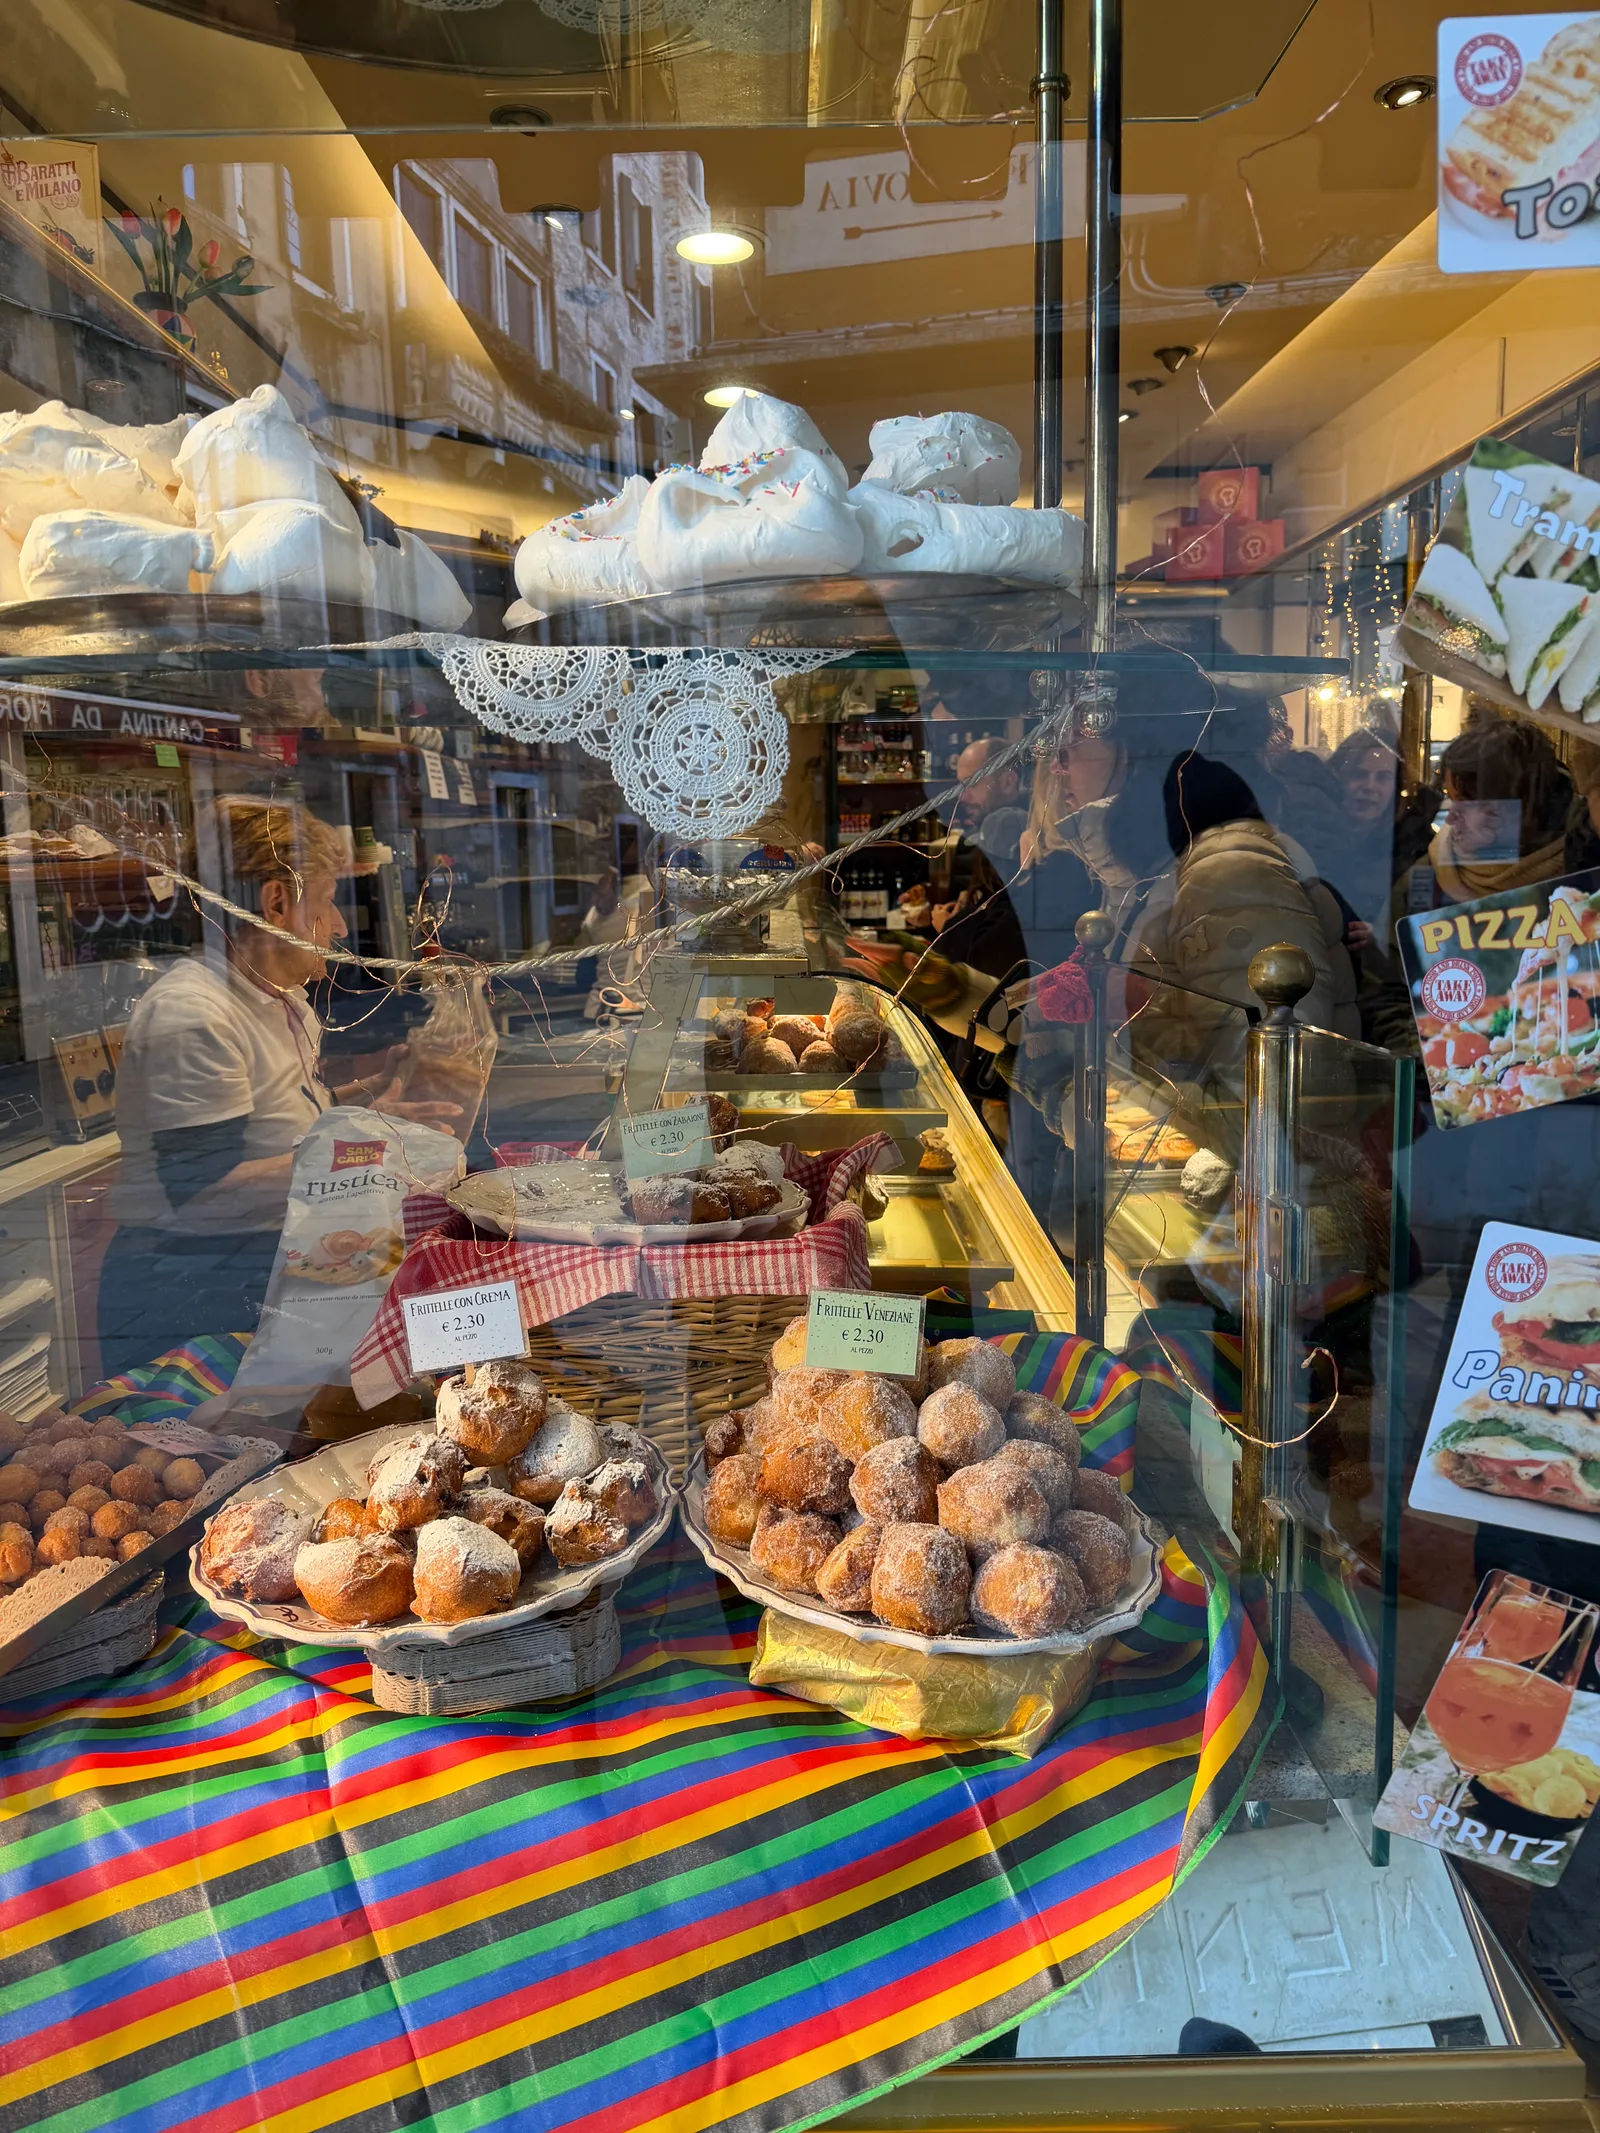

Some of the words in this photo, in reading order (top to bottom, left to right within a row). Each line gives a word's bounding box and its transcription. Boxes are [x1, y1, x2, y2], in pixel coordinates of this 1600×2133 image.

[15, 160, 77, 185] BARATTI
[15, 189, 24, 201] E
[25, 178, 82, 202] MILANO
[1501, 172, 1600, 240] To
[1488, 469, 1600, 557] Tram
[1420, 898, 1587, 954] PIZZA
[1435, 979, 1473, 991] TAKE
[1435, 989, 1472, 1002] AWAY
[623, 1121, 660, 1135] FRITTELLE
[659, 1118, 673, 1128] CON
[672, 1112, 706, 1126] ZABAIONE
[650, 1137, 658, 1147] €
[659, 1130, 684, 1145] 2.30
[336, 1152, 380, 1164] CARLO
[346, 1146, 374, 1156] SAN
[305, 1169, 400, 1197] rustica
[1499, 1262, 1536, 1274] TAKE
[1499, 1272, 1535, 1285] AWAY
[410, 1299, 454, 1317] FRITTELLE
[454, 1295, 474, 1309] CON
[474, 1289, 511, 1306] CREMA
[816, 1297, 863, 1320] FRITTELLE
[864, 1301, 915, 1324] VENEZIANE
[442, 1321, 450, 1332] €
[453, 1313, 485, 1331] 2.30
[841, 1329, 850, 1341] €
[853, 1327, 884, 1344] 2.30
[1410, 1793, 1568, 1866] SPRITZ
